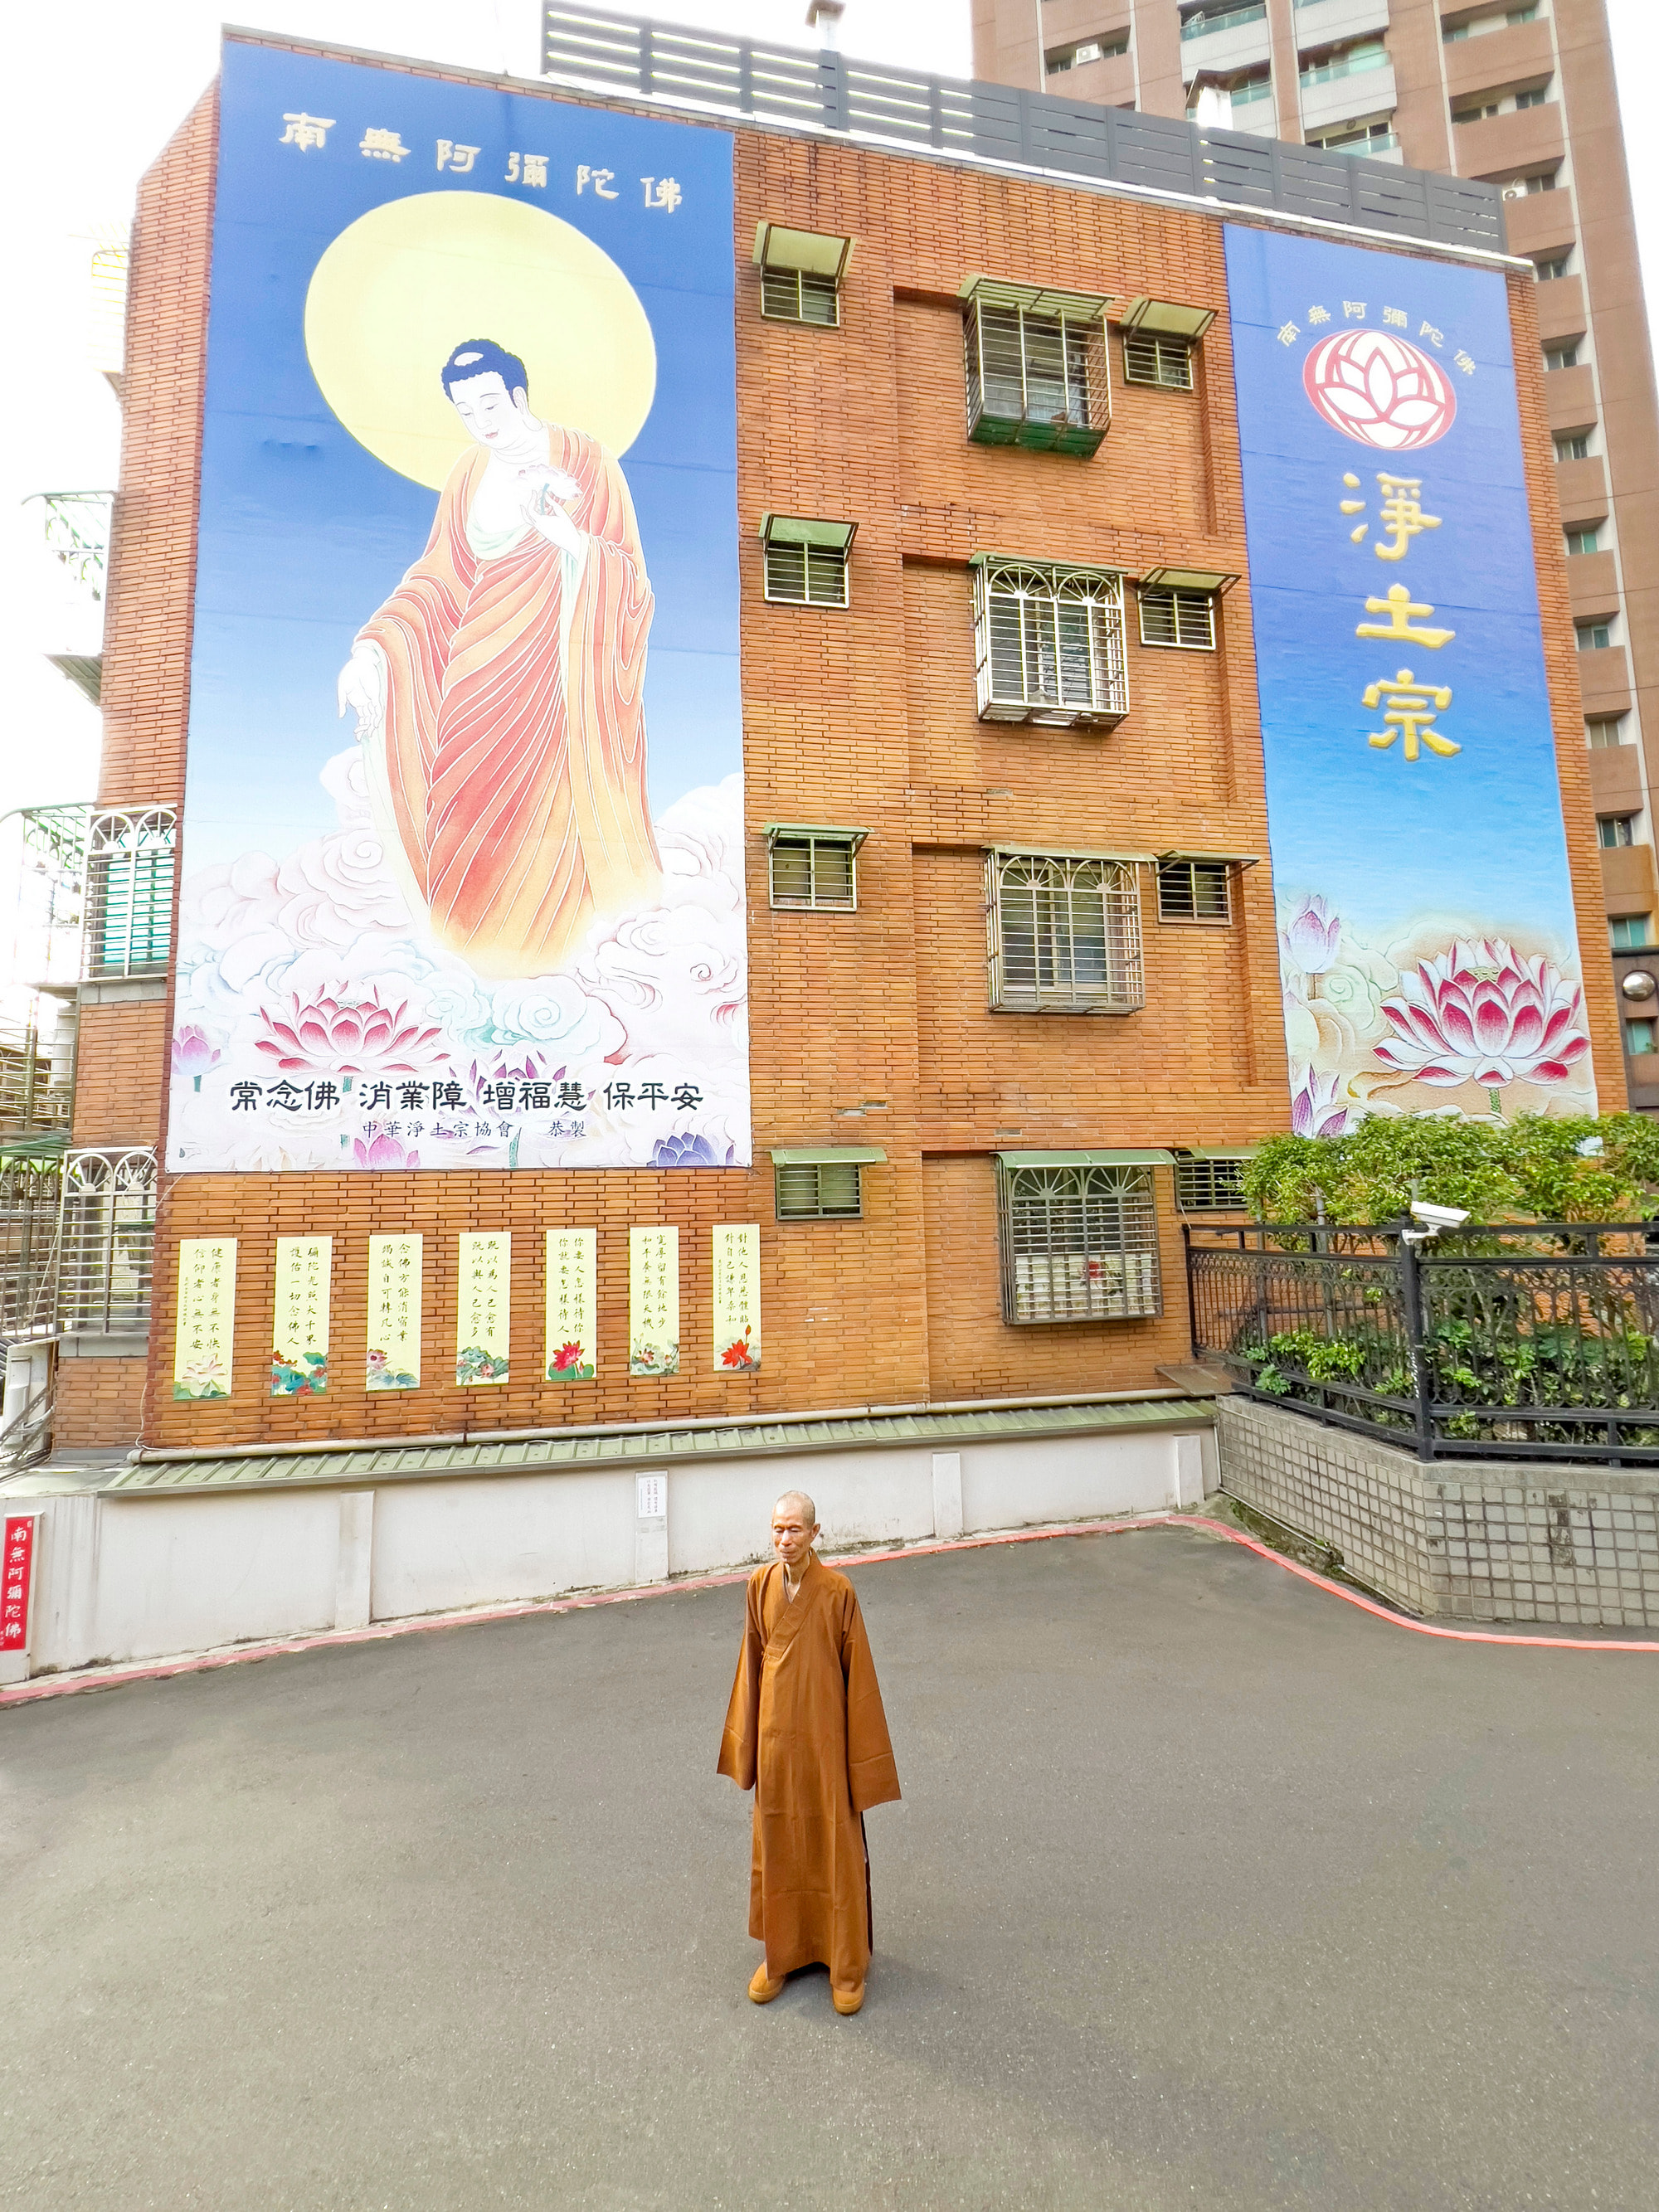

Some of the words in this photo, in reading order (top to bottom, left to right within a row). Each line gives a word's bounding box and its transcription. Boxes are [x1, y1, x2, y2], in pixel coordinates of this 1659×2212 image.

[279, 112, 683, 213] 南無阿彌陀佛
[1277, 300, 1477, 375] 南無阿彌陀佛
[1340, 473, 1462, 761] 淨土宗
[230, 1081, 339, 1111] 常念佛
[358, 1081, 467, 1111] 消業障
[484, 1081, 587, 1111] 增福慧
[603, 1081, 704, 1111] 保平安
[362, 1121, 513, 1138] 中華淨土宗協會
[548, 1121, 586, 1138] 恭製
[5, 1526, 27, 1638] 南無阿彌陀佛
